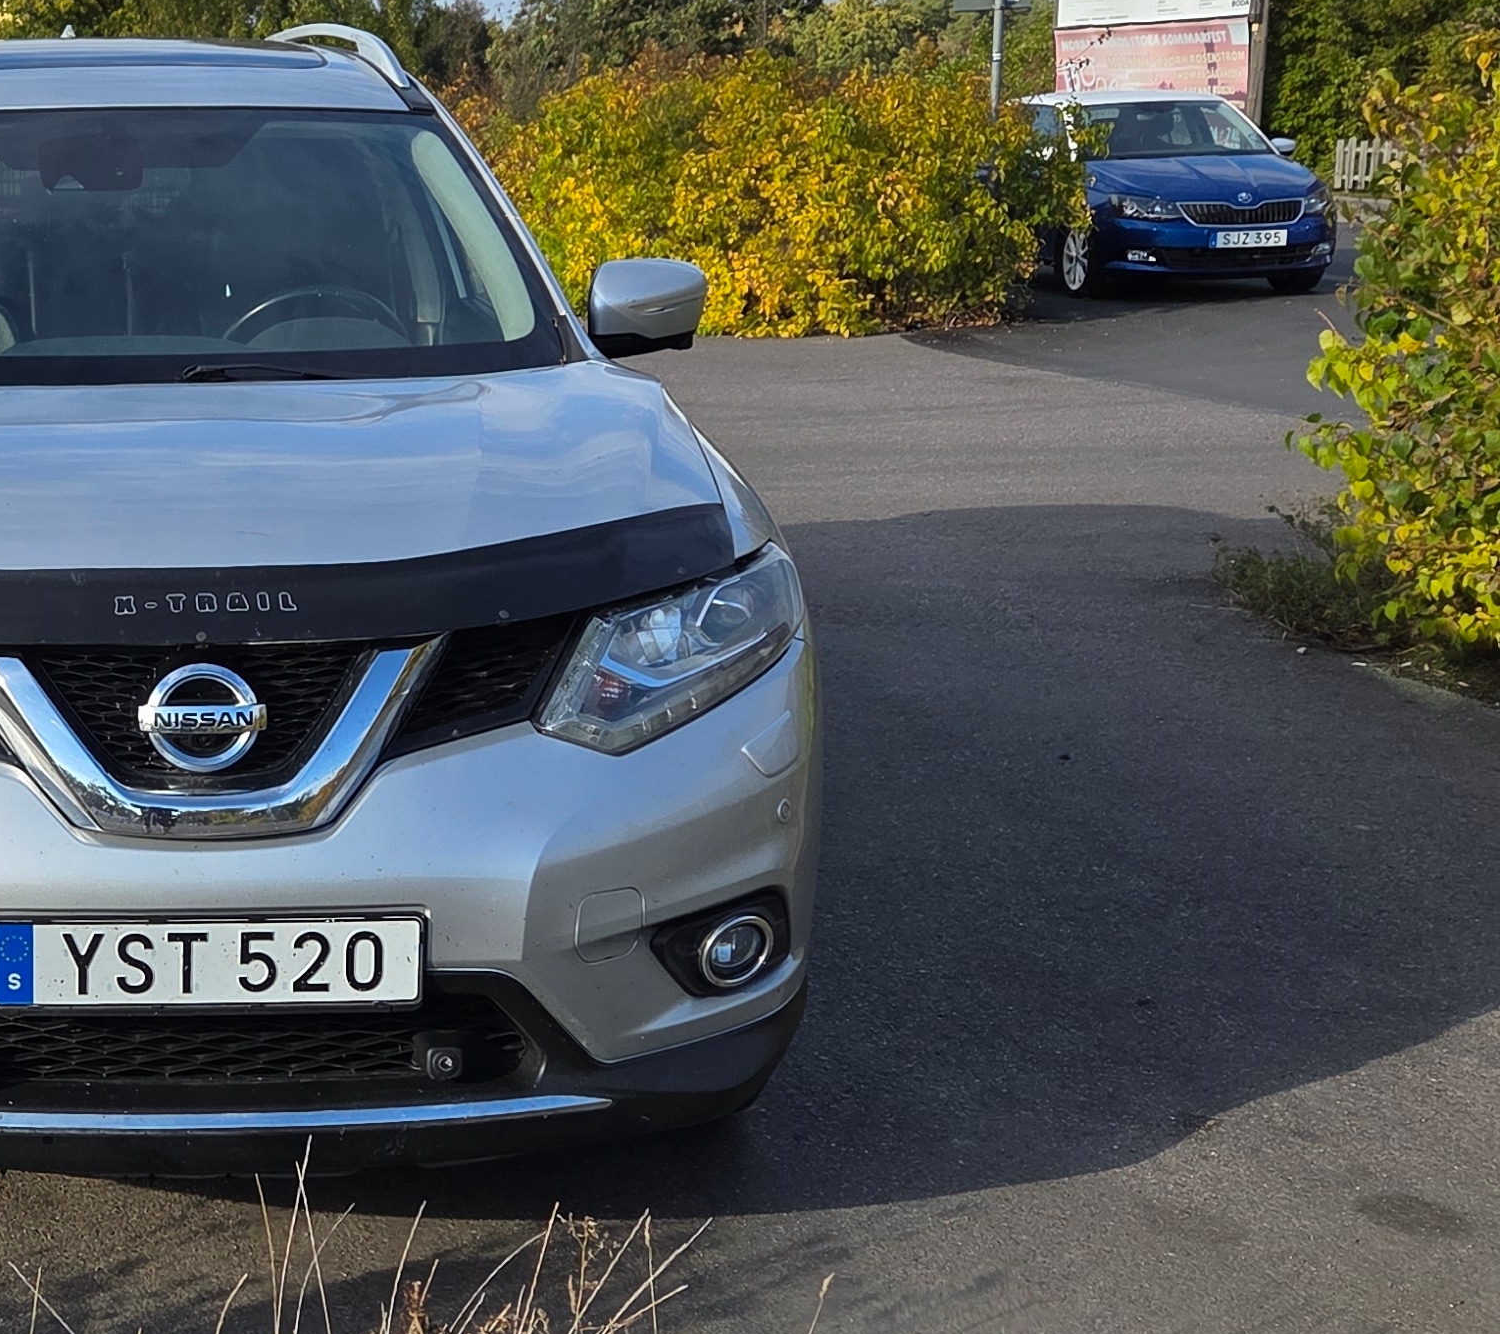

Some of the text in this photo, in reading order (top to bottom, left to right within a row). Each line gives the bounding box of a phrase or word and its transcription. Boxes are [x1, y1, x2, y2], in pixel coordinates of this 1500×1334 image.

[1223, 232, 1281, 246] SJZ 395
[114, 592, 298, 615] X-TRAIL
[154, 710, 254, 728] NISSAN
[62, 930, 385, 995] YST 520
[8, 973, 21, 990] S
